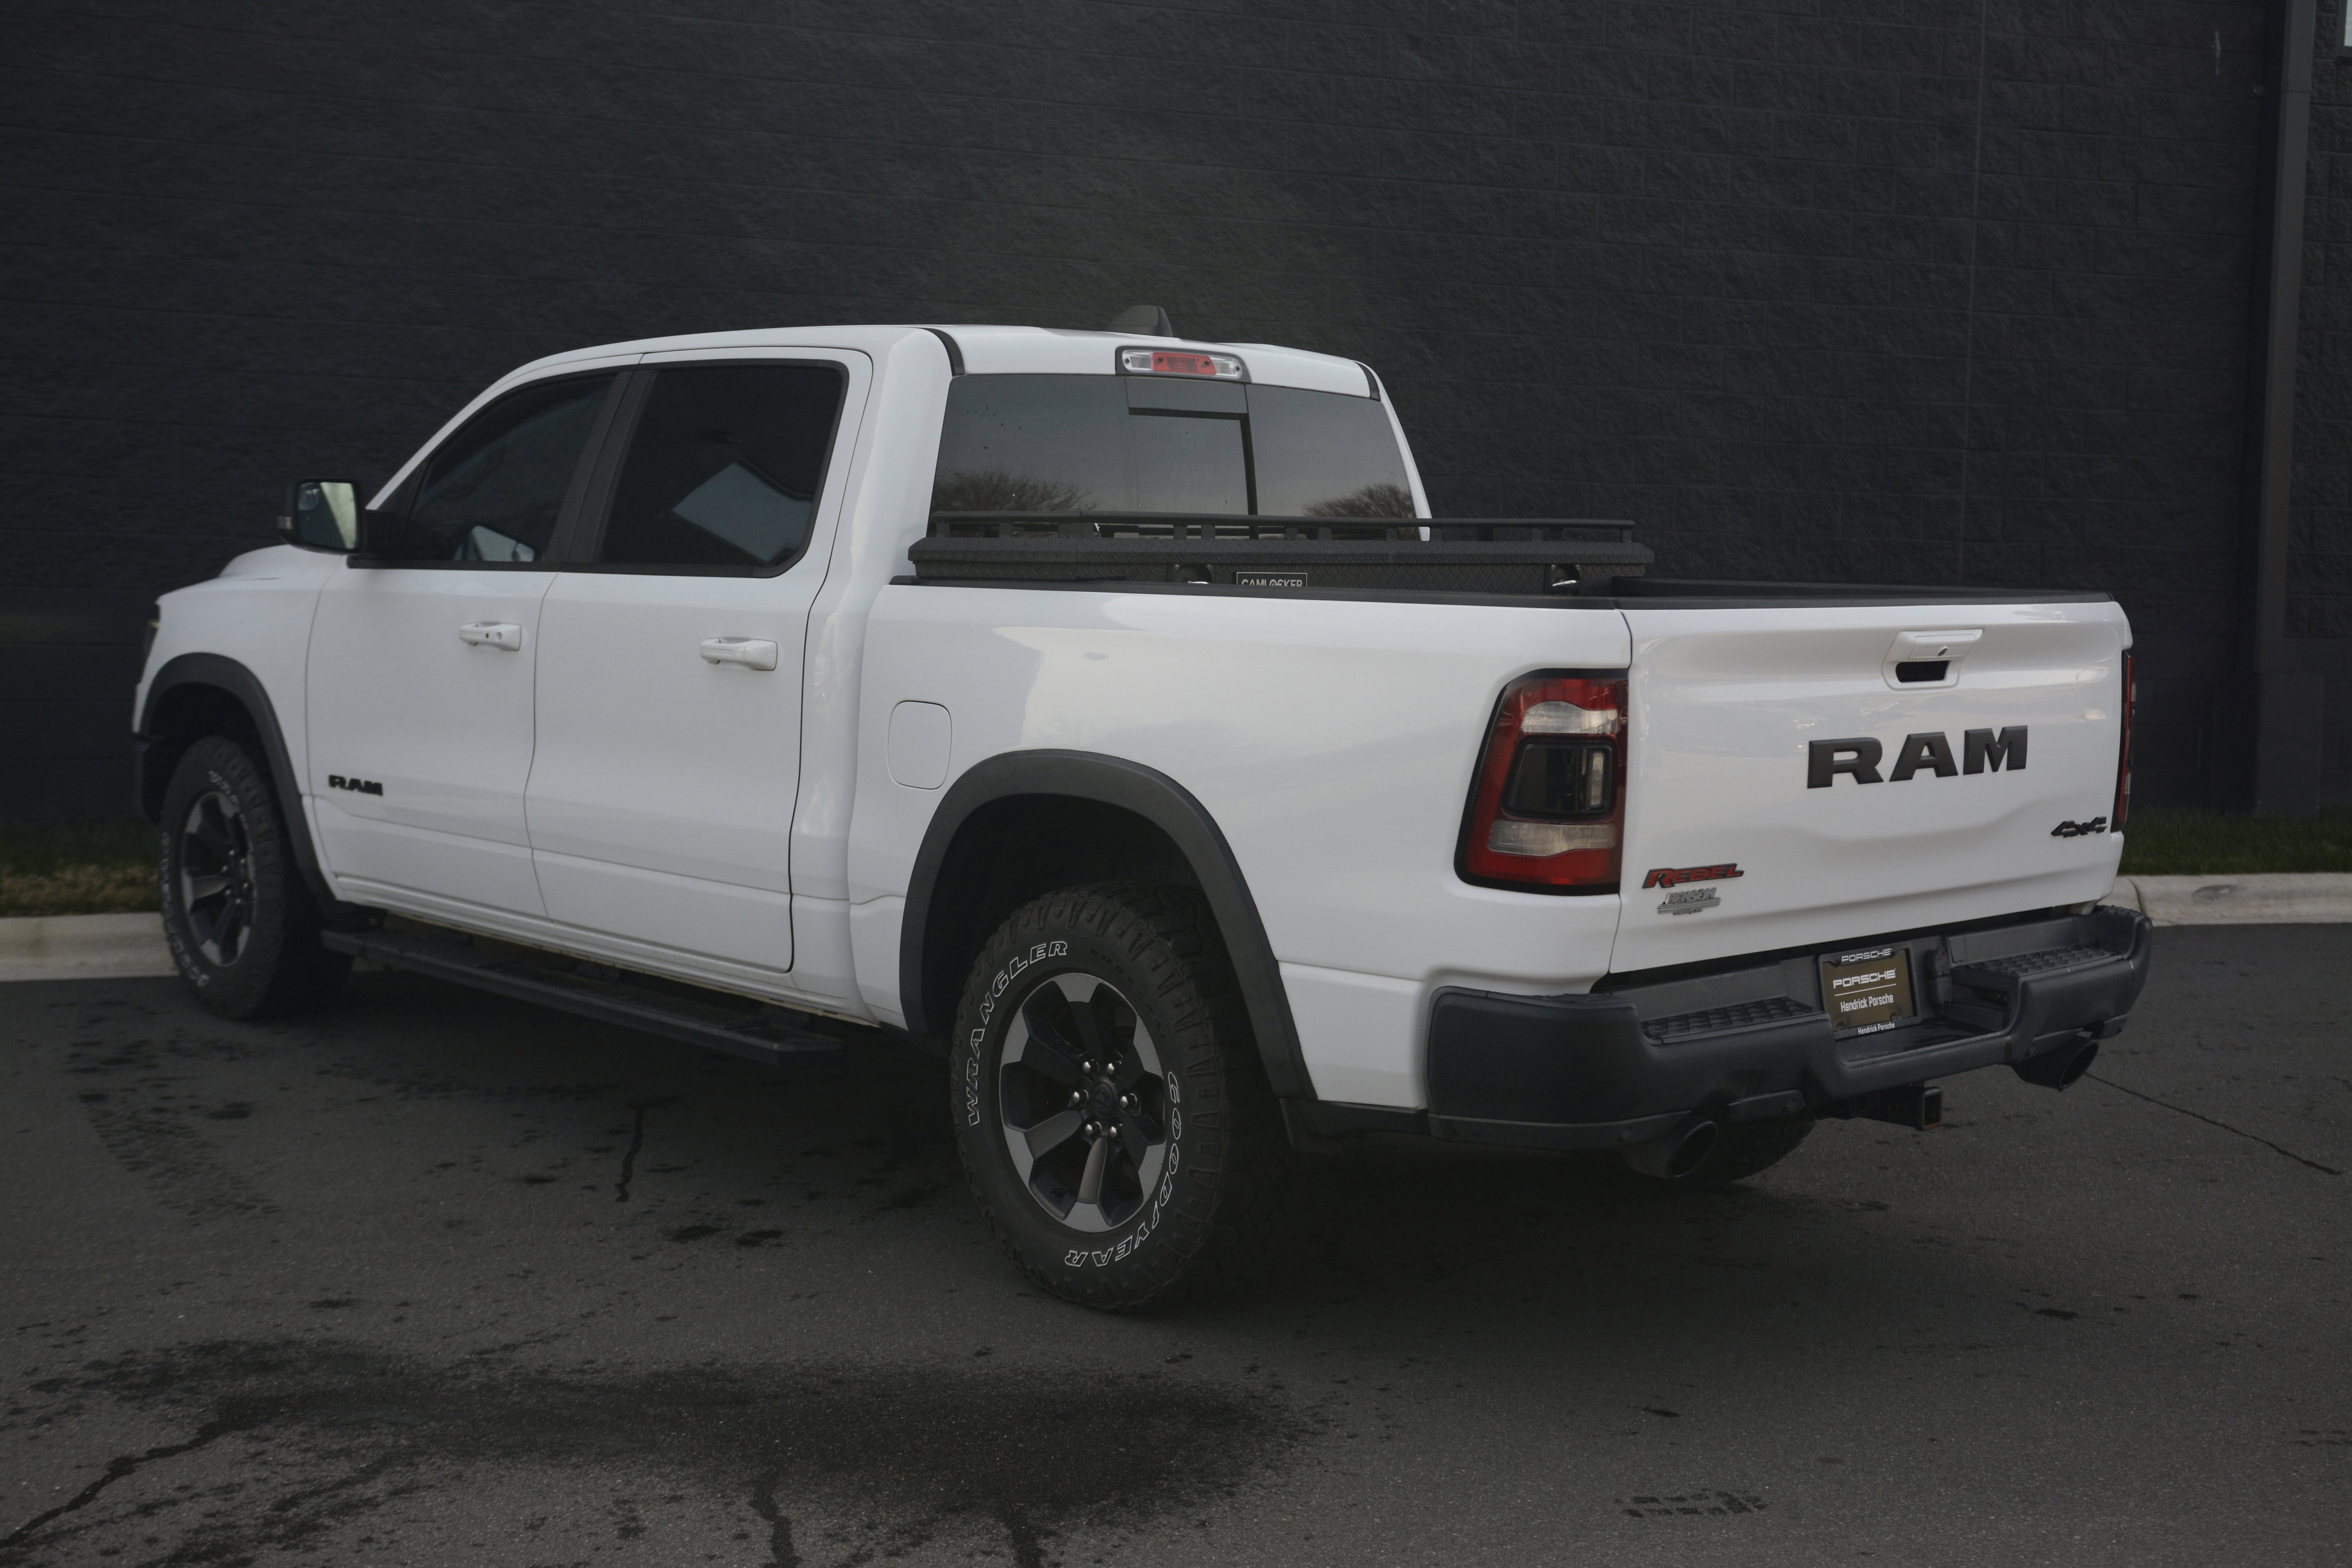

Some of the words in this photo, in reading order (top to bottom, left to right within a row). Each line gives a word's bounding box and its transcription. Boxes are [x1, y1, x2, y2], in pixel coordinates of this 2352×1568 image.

[1807, 725, 2028, 789] RAM
[328, 775, 383, 796] RAM
[1642, 863, 1744, 889] REBEL
[1841, 948, 1891, 962] PORSCHE
[1833, 969, 1896, 989] PORSCHE
[1840, 998, 1868, 1012] Hendrick
[1868, 993, 1894, 1007] Porsche
[967, 940, 1068, 1127] WRANGLER
[1858, 1025, 1878, 1035] Hendrick
[1878, 1022, 1895, 1031] Porsche
[1064, 1071, 1181, 1267] GOODYEAR
